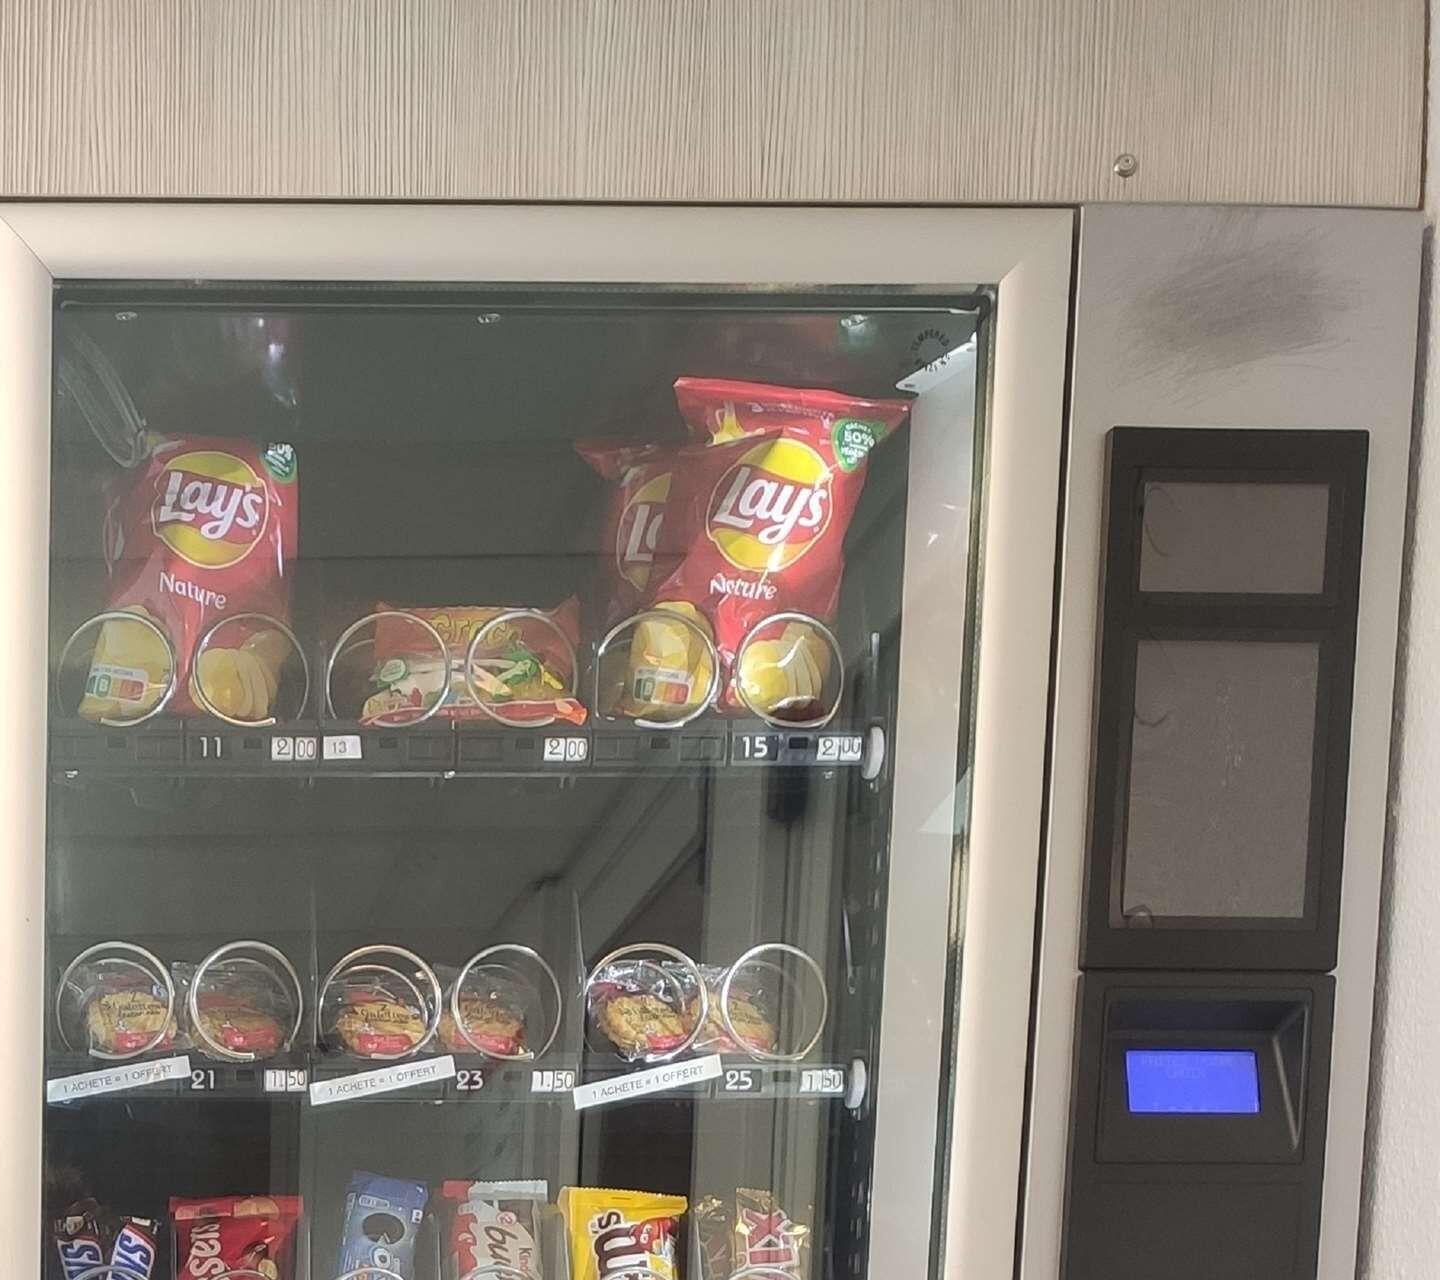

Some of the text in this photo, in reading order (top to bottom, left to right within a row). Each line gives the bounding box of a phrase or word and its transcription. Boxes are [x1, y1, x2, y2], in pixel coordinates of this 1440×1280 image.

[158, 471, 263, 540] Lay's
[712, 466, 828, 546] Lay's
[160, 572, 227, 610] Nature
[200, 737, 221, 758] 11
[333, 741, 347, 754] 13
[742, 736, 767, 758] 15
[191, 1070, 215, 1089] 21
[336, 1078, 377, 1094] ACHETE
[396, 1065, 437, 1083] OFFERT
[457, 1070, 483, 1090] 23
[660, 1064, 705, 1084] OFFERT
[725, 1070, 753, 1090] 25
